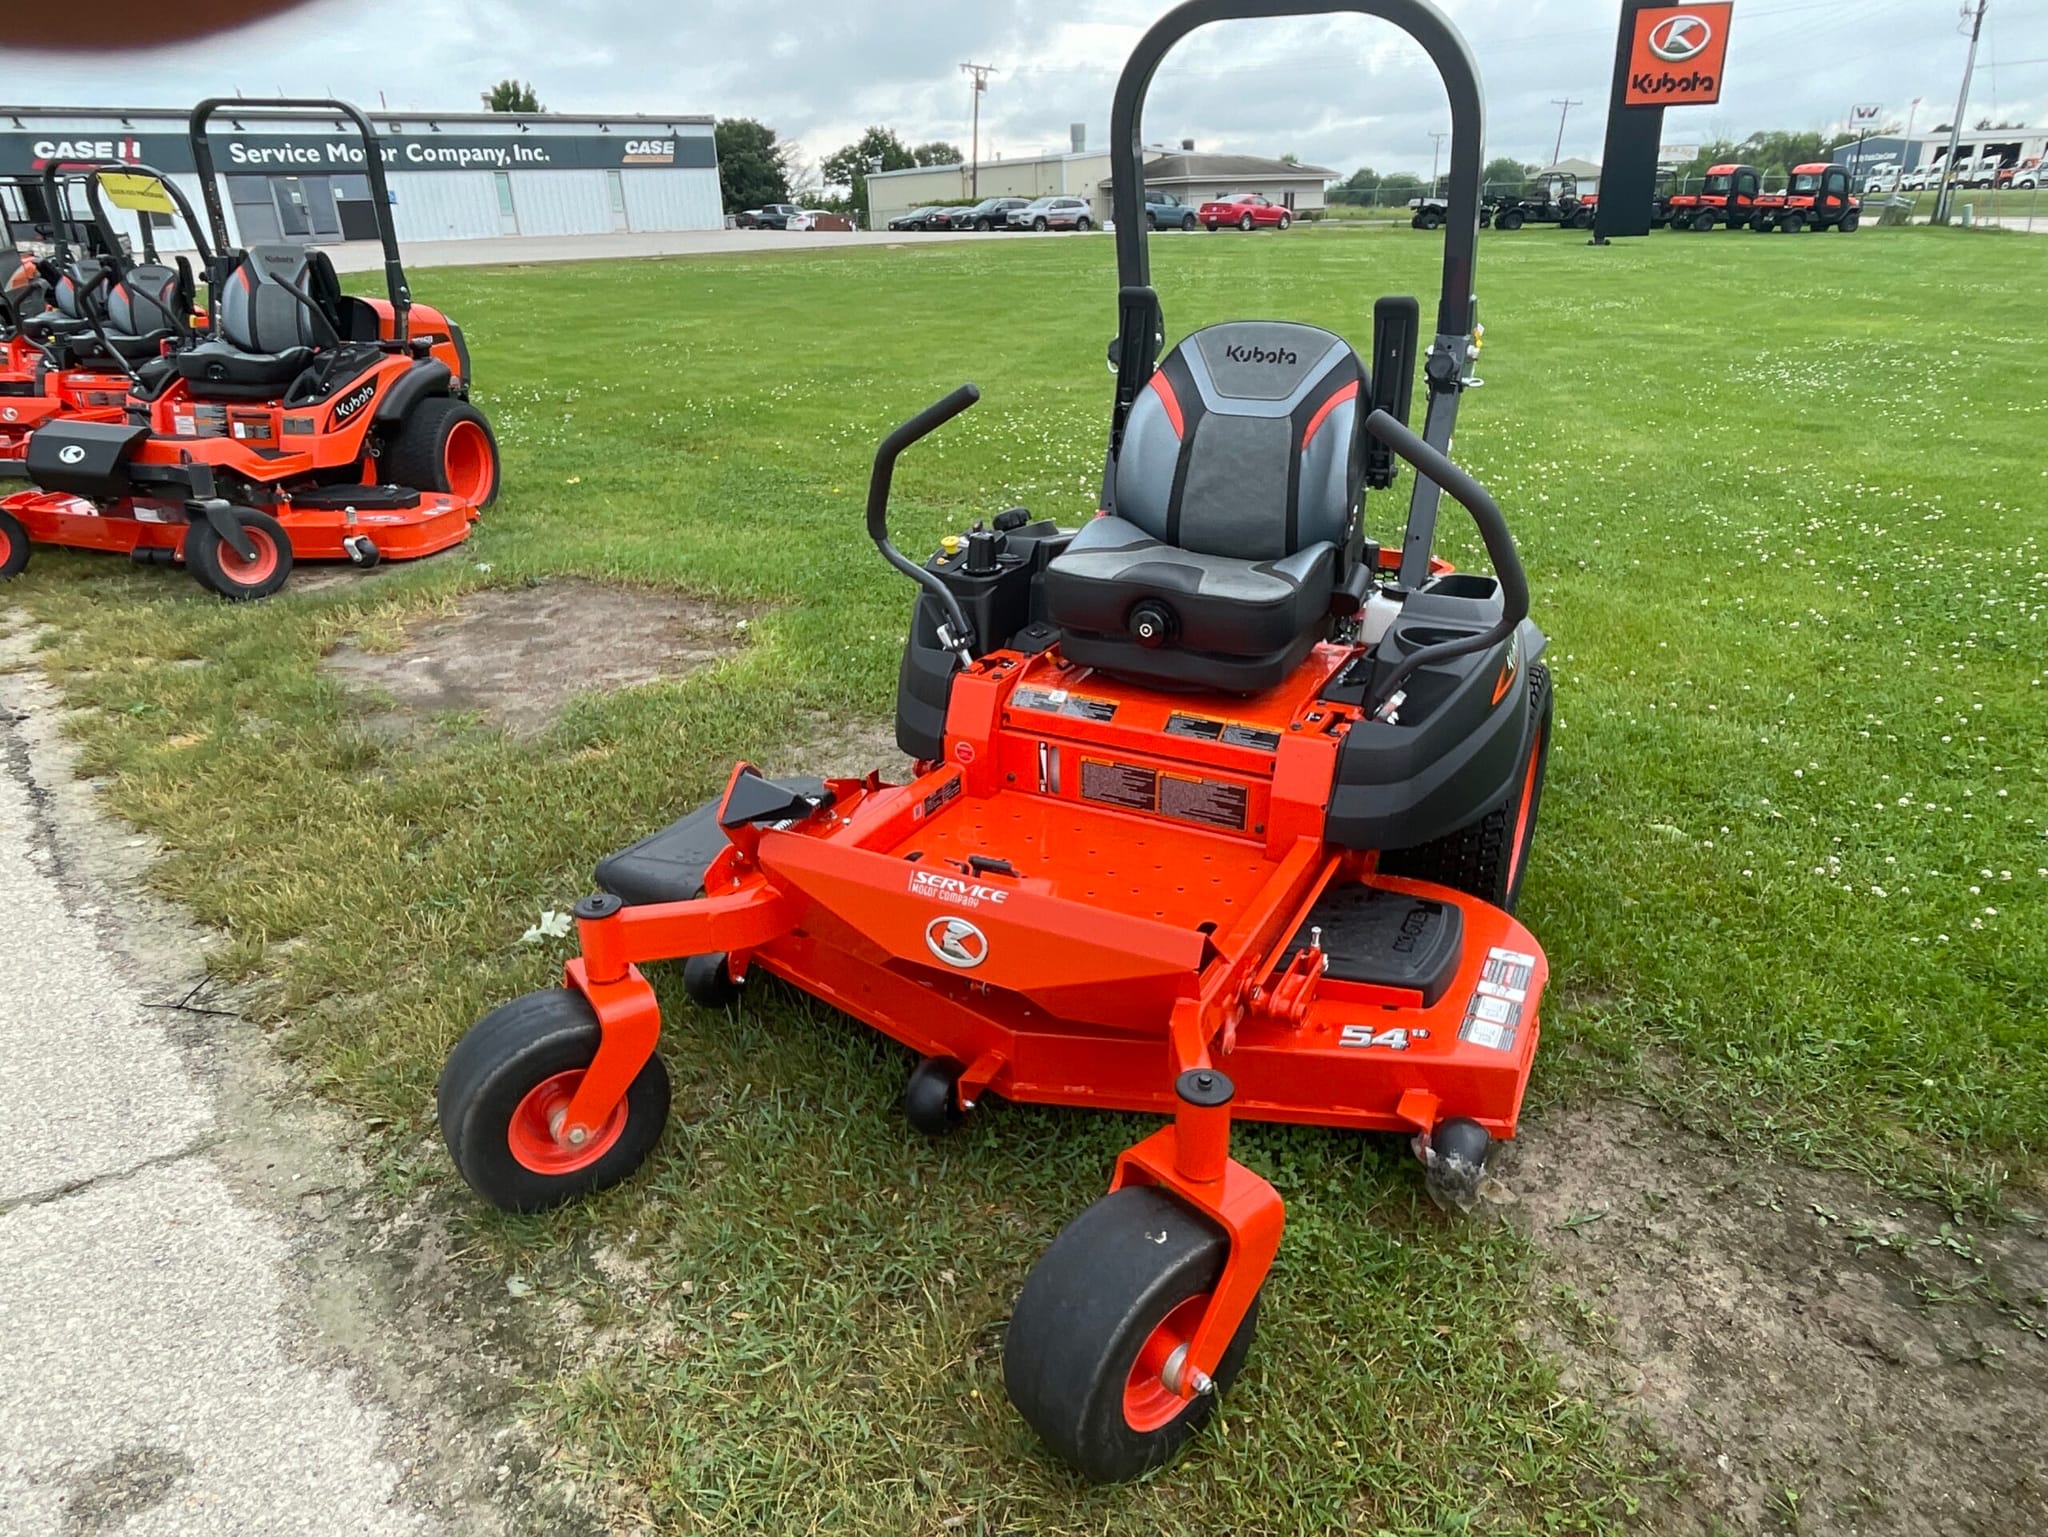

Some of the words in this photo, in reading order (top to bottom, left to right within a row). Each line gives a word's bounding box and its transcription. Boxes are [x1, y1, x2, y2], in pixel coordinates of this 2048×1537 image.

[1632, 71, 1714, 94] Kubota
[33, 141, 113, 159] CASE
[229, 143, 321, 163] Service
[406, 143, 511, 167] Company,
[513, 144, 550, 162] Inc.
[625, 140, 675, 154] CASE
[1226, 345, 1297, 365] Kubota
[336, 385, 374, 416] Kubota
[914, 871, 1009, 904] SERVICE
[1339, 1025, 1430, 1050] 54"
